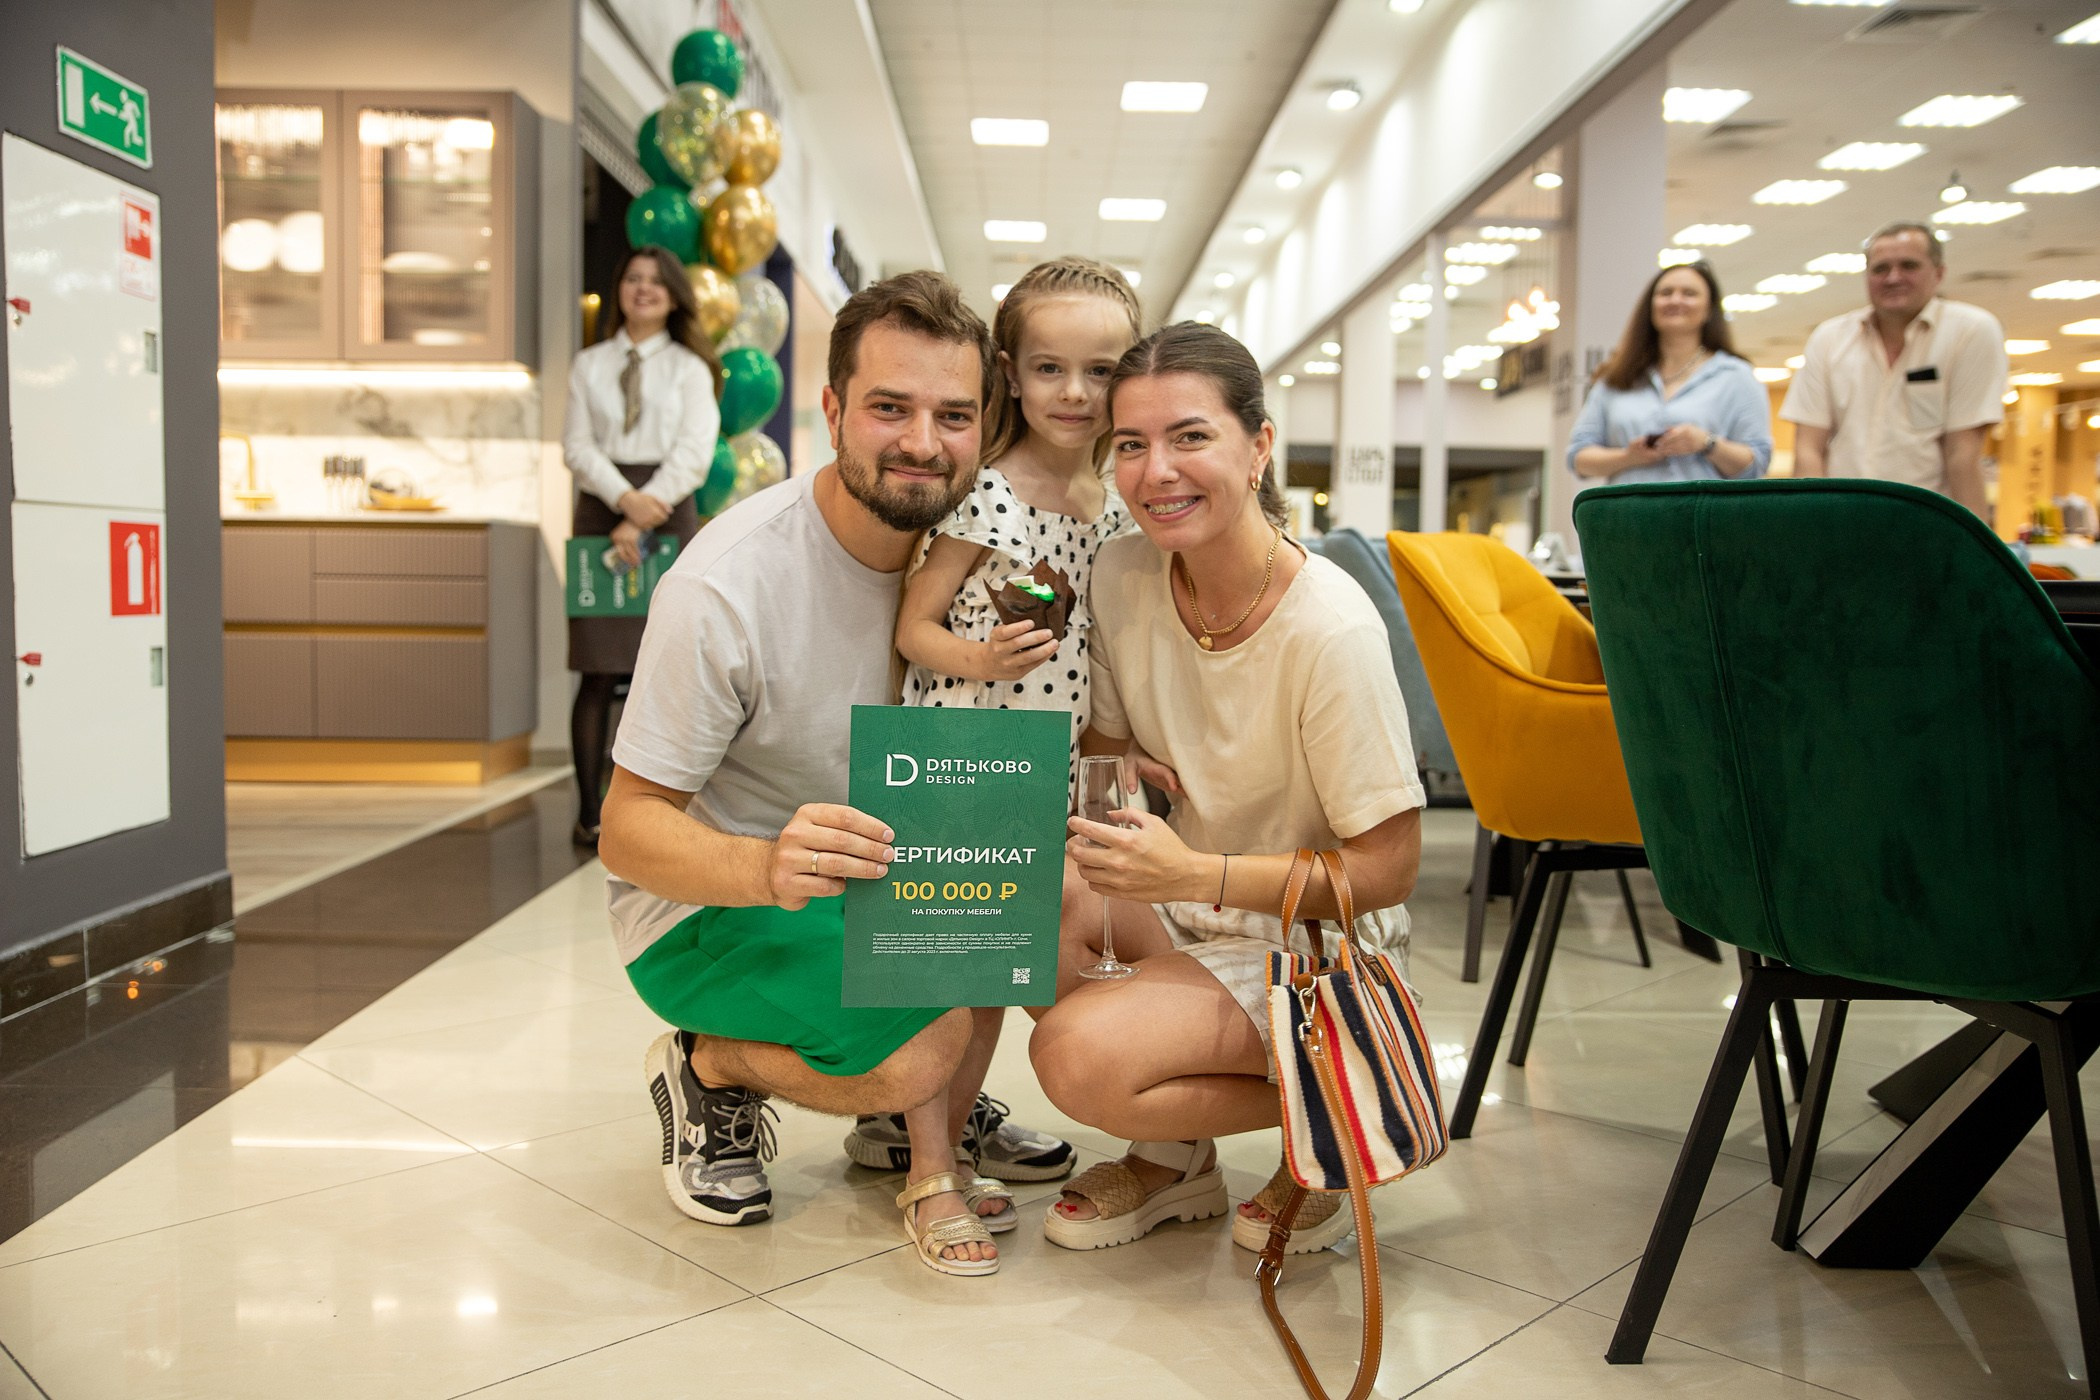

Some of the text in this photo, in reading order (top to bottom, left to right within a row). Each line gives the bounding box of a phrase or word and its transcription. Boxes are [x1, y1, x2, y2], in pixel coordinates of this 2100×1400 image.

[926, 775, 975, 785] DESIGN
[893, 846, 1036, 864] ЕРТИФИКАТ
[891, 881, 935, 900] 100
[942, 882, 992, 901] 000
[911, 908, 1002, 916] НА ПОКУПКУ МЕБЕЛИ
